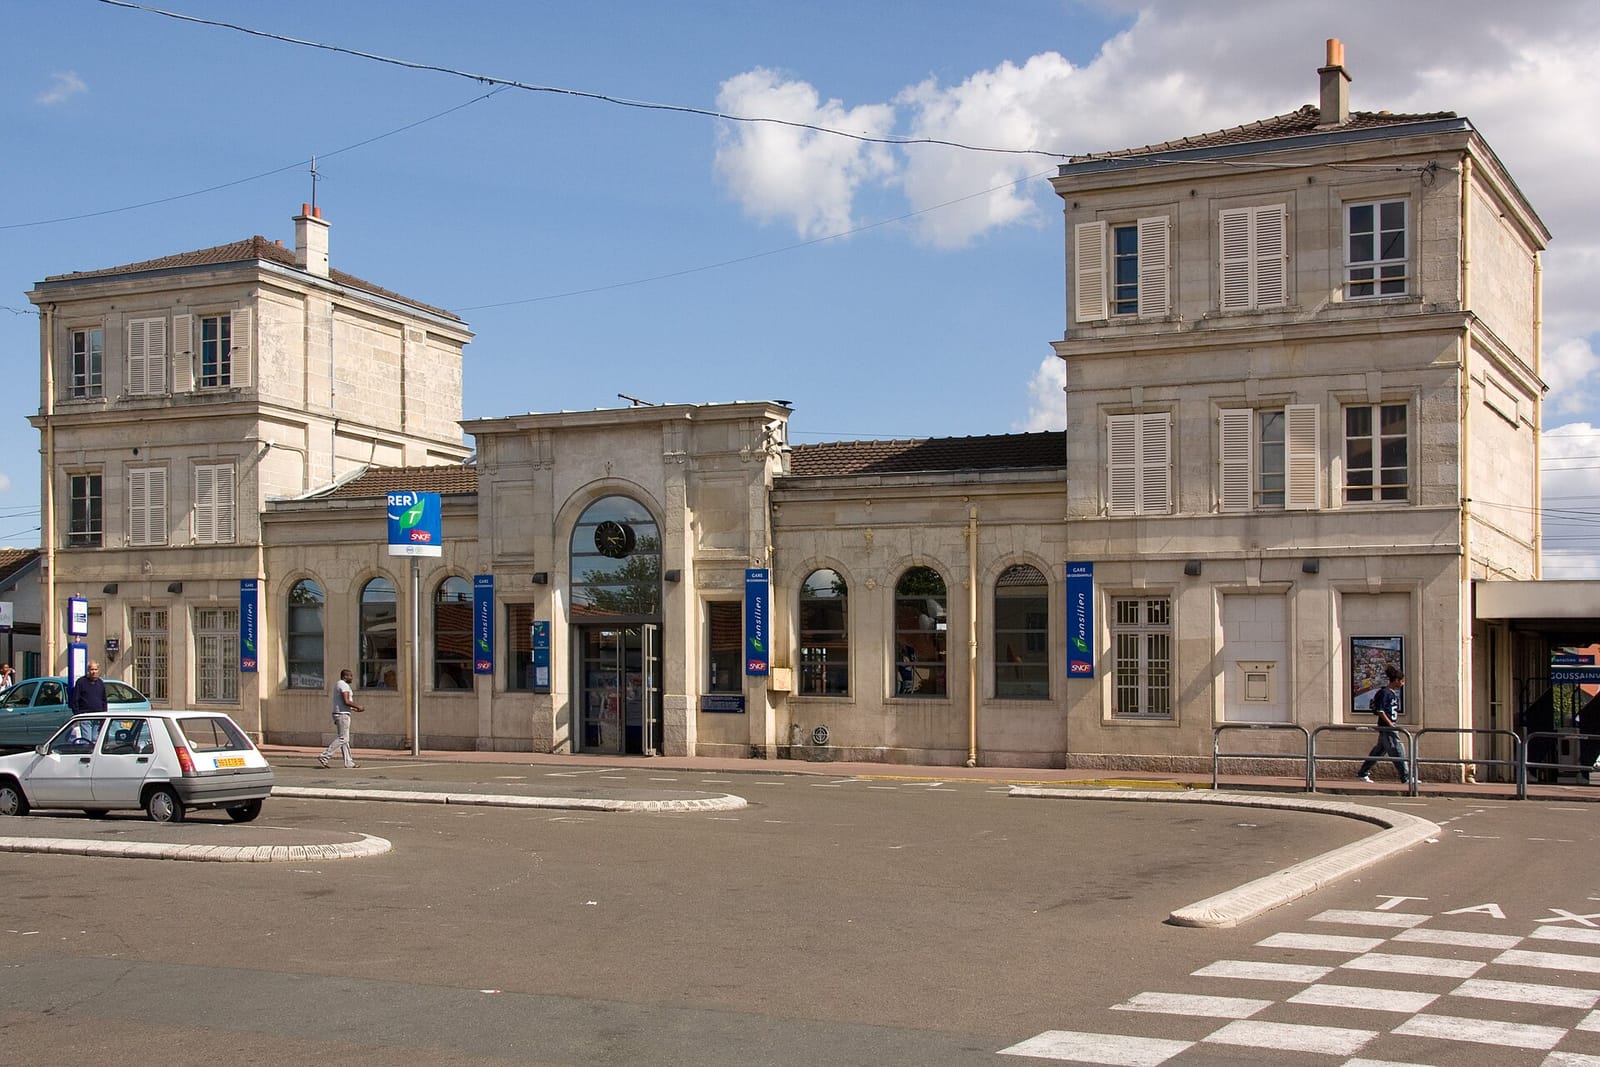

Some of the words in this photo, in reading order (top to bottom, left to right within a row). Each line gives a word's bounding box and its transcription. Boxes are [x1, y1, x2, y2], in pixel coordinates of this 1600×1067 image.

[387, 495, 412, 506] RER
[411, 533, 431, 541] SNCF
[754, 596, 762, 648] Transilien
[1077, 592, 1086, 648] Transilien
[243, 660, 256, 668] SNCF
[477, 662, 491, 670] SNCF
[749, 662, 766, 670] SNCF
[1071, 664, 1089, 672] SNCF
[1391, 705, 1397, 720] 5
